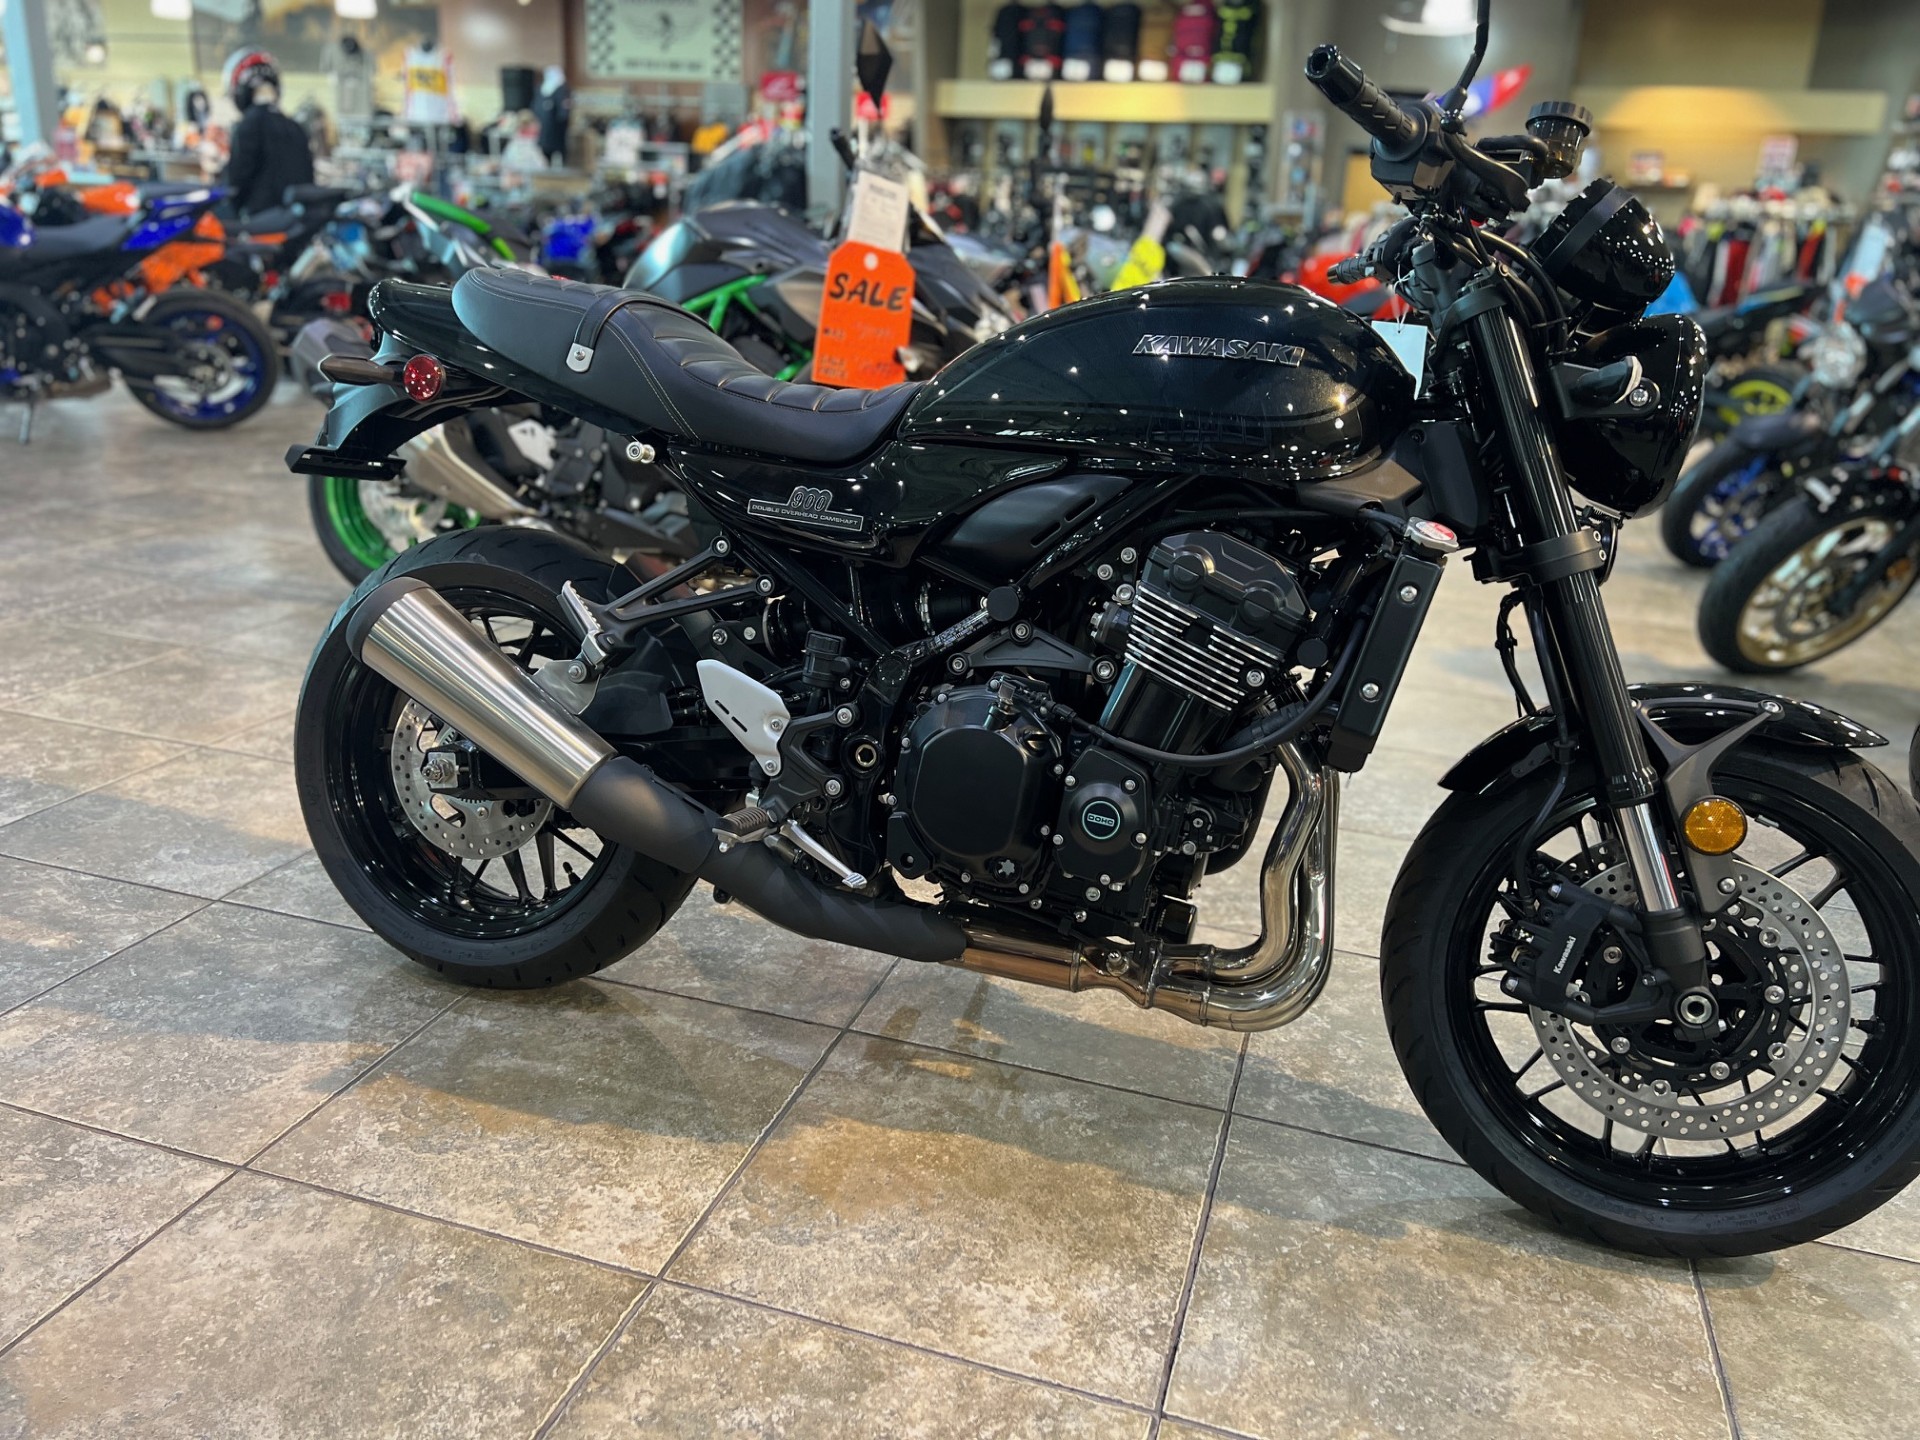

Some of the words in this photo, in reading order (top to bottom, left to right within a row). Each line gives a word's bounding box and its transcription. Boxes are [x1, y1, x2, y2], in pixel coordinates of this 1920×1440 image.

[829, 272, 907, 311] SALE
[1132, 334, 1306, 367] KAWASAKI
[752, 504, 780, 513] DOUBLE
[781, 508, 818, 519] OVERHEAD
[820, 514, 859, 525] CAMSHAFT
[791, 491, 827, 512] 900
[1088, 813, 1114, 826] DOHC
[1553, 935, 1577, 974] Kawasaki
